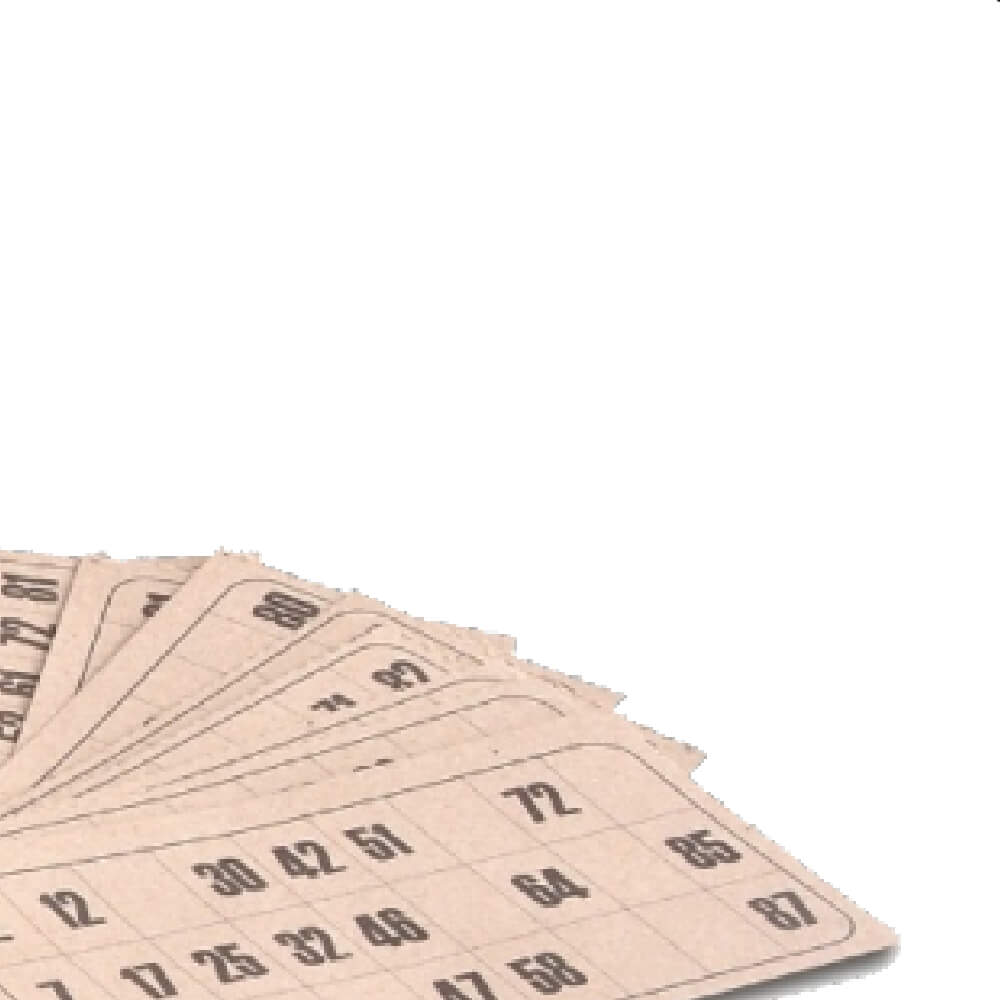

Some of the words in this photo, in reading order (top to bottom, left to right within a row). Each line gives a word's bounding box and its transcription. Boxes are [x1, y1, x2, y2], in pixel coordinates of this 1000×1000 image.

[0, 571, 60, 602] 81
[252, 591, 321, 631] 80
[39, 891, 108, 931] 12
[190, 858, 270, 896] 30
[271, 839, 347, 880] 42
[342, 823, 415, 860] 51
[500, 781, 583, 825] 72
[190, 942, 270, 986] 25
[272, 926, 354, 967] 32
[354, 907, 431, 947] 46
[510, 867, 591, 909] 64
[664, 829, 743, 870] 85
[506, 952, 589, 996] 58
[746, 891, 818, 931] 87
